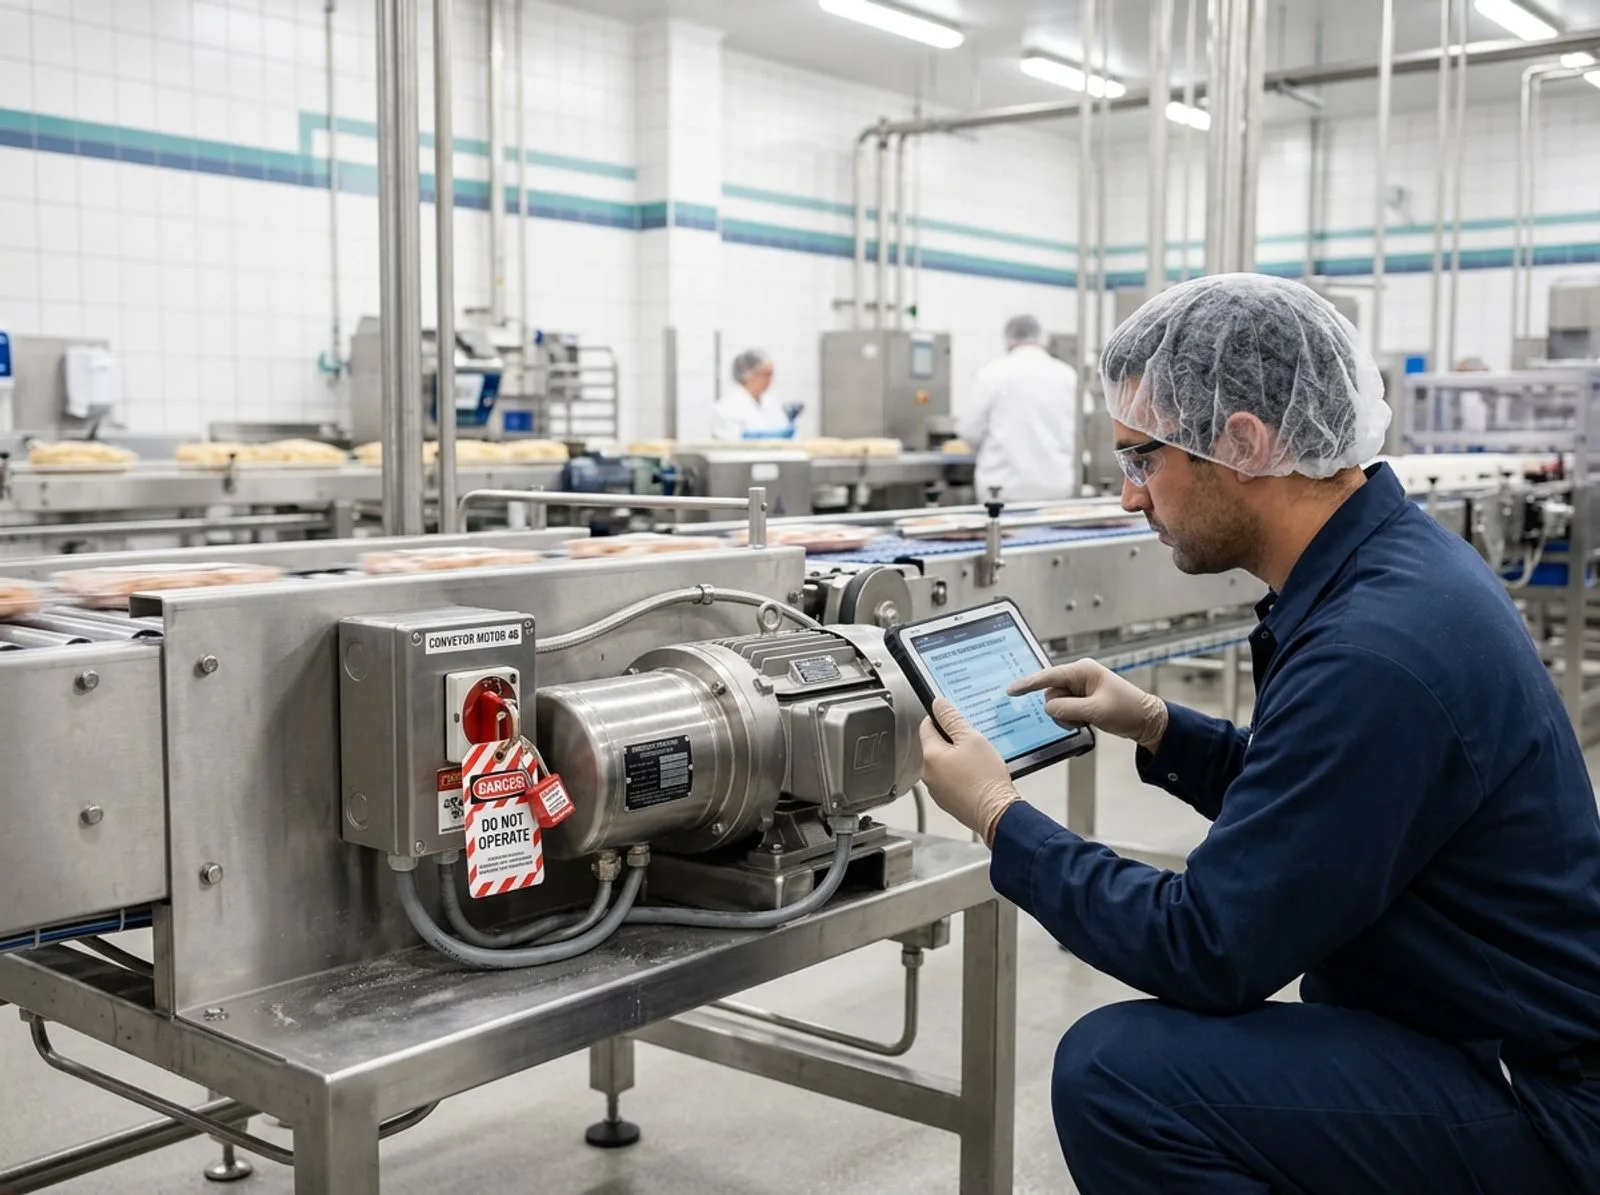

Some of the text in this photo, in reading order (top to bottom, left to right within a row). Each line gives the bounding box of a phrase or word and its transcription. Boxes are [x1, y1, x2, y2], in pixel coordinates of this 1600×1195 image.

[481, 817, 498, 833] DO
[501, 812, 524, 829] NOT
[478, 827, 530, 850] OPERATE
